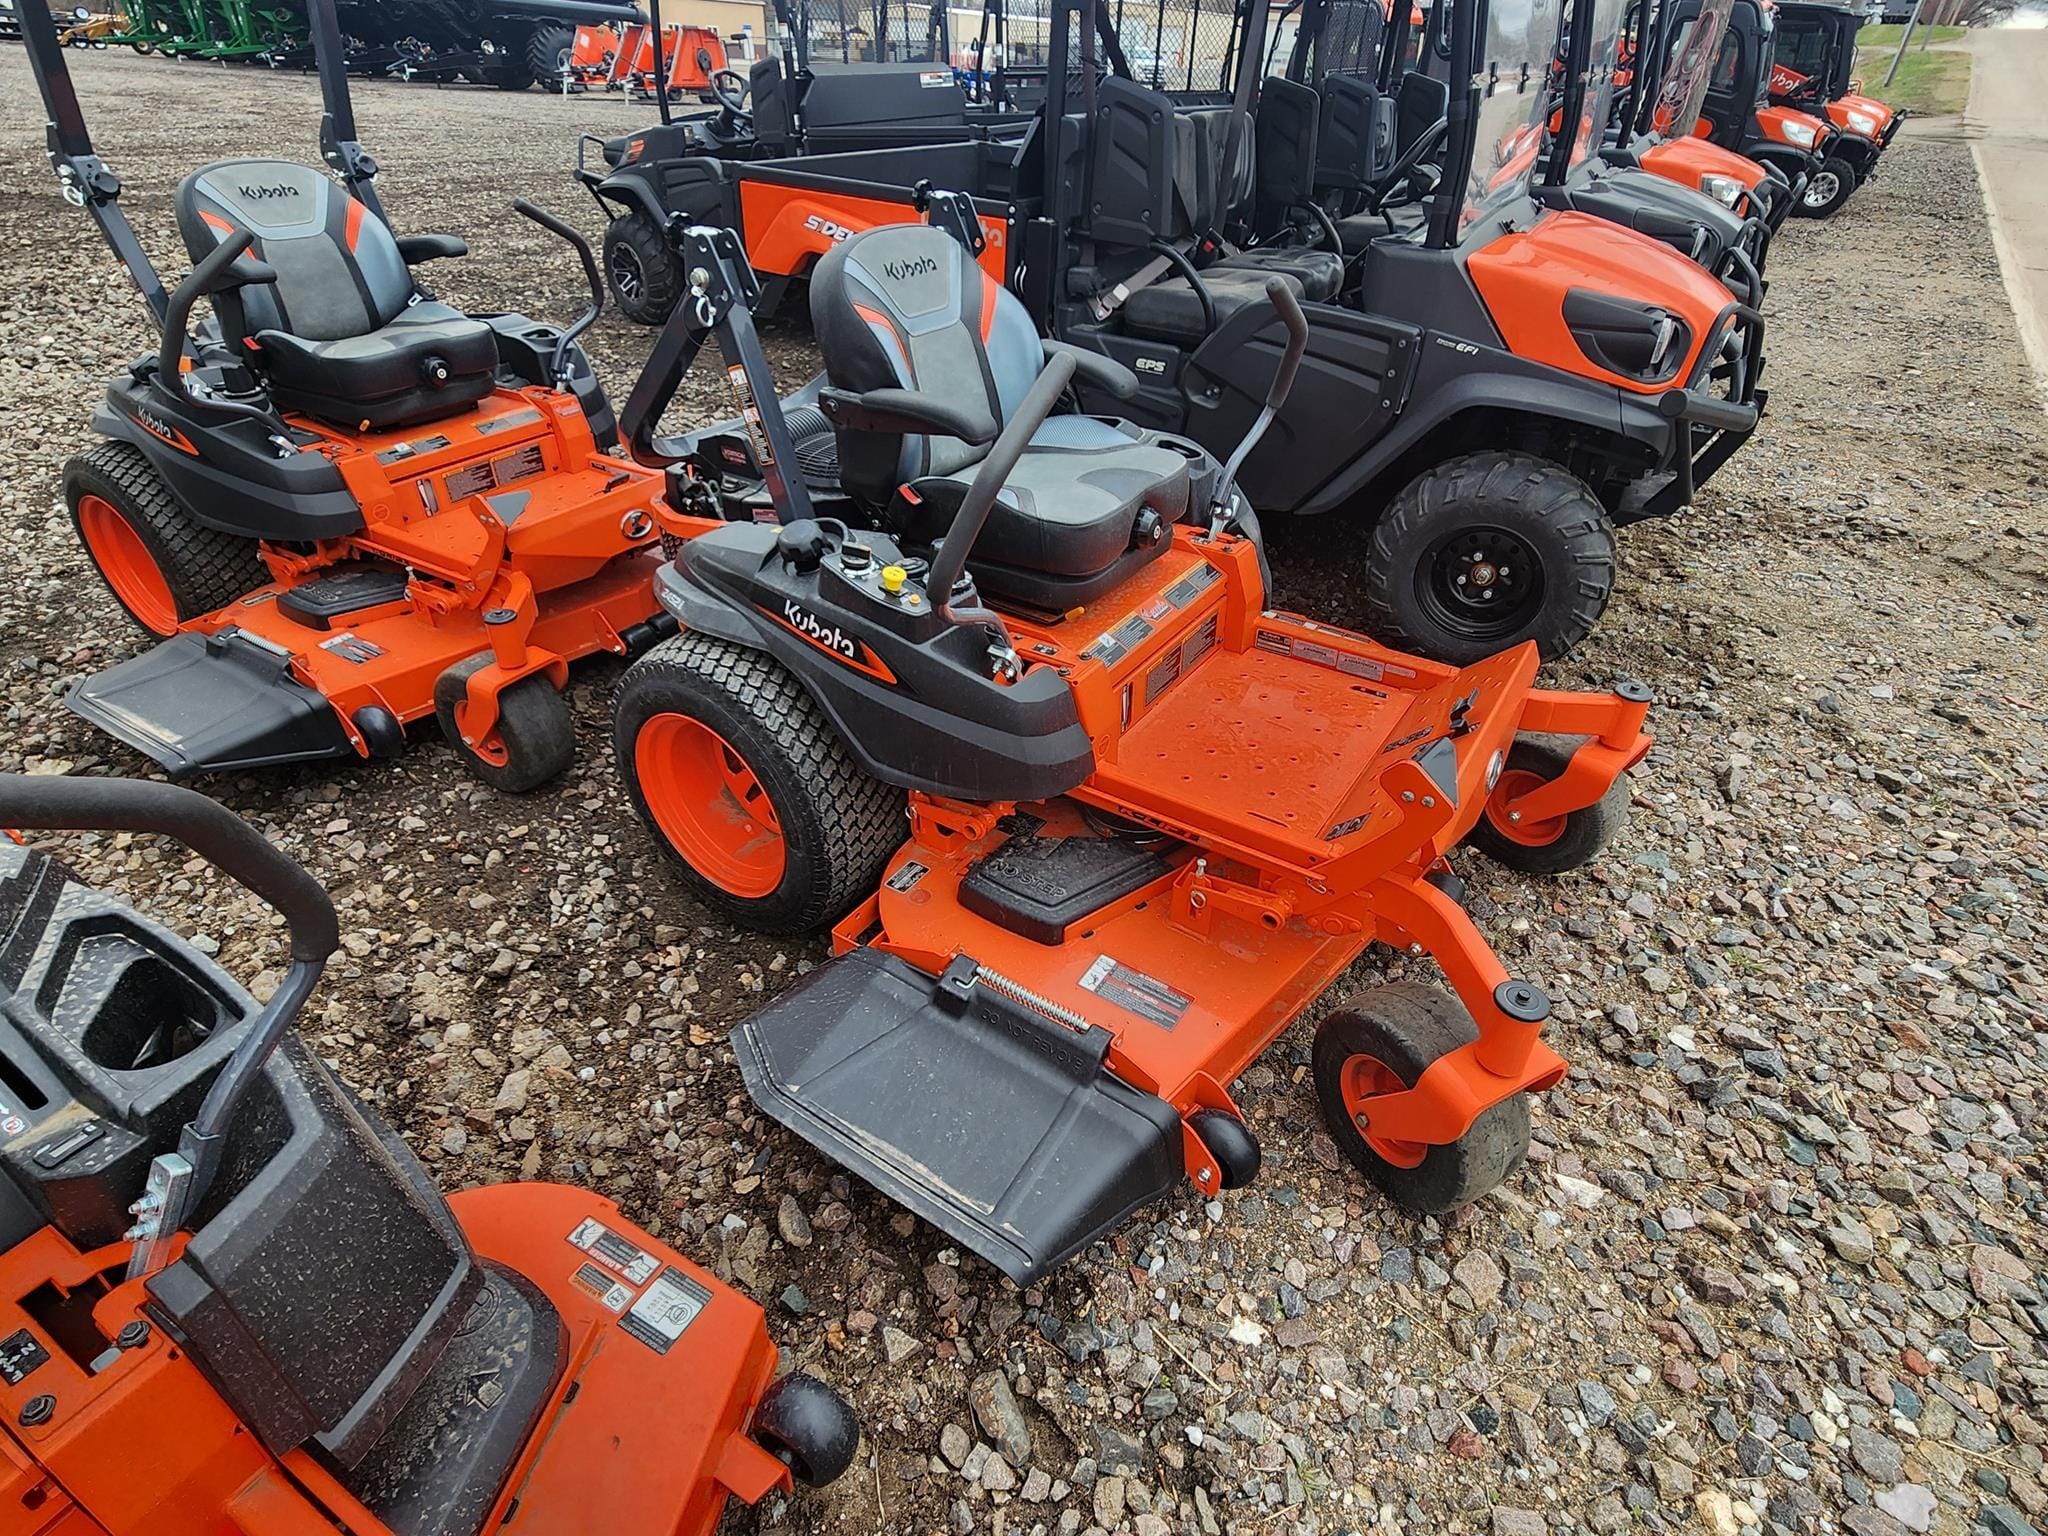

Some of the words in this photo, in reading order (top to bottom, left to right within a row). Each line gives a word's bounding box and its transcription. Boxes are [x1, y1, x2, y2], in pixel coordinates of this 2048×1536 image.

[238, 183, 299, 200] Kubota
[884, 256, 936, 281] Kubota
[1455, 342, 1480, 356] EFI
[1135, 357, 1166, 372] EPS
[137, 405, 172, 439] Kubota
[784, 599, 855, 658] Kubota
[1019, 872, 1067, 898] STEP
